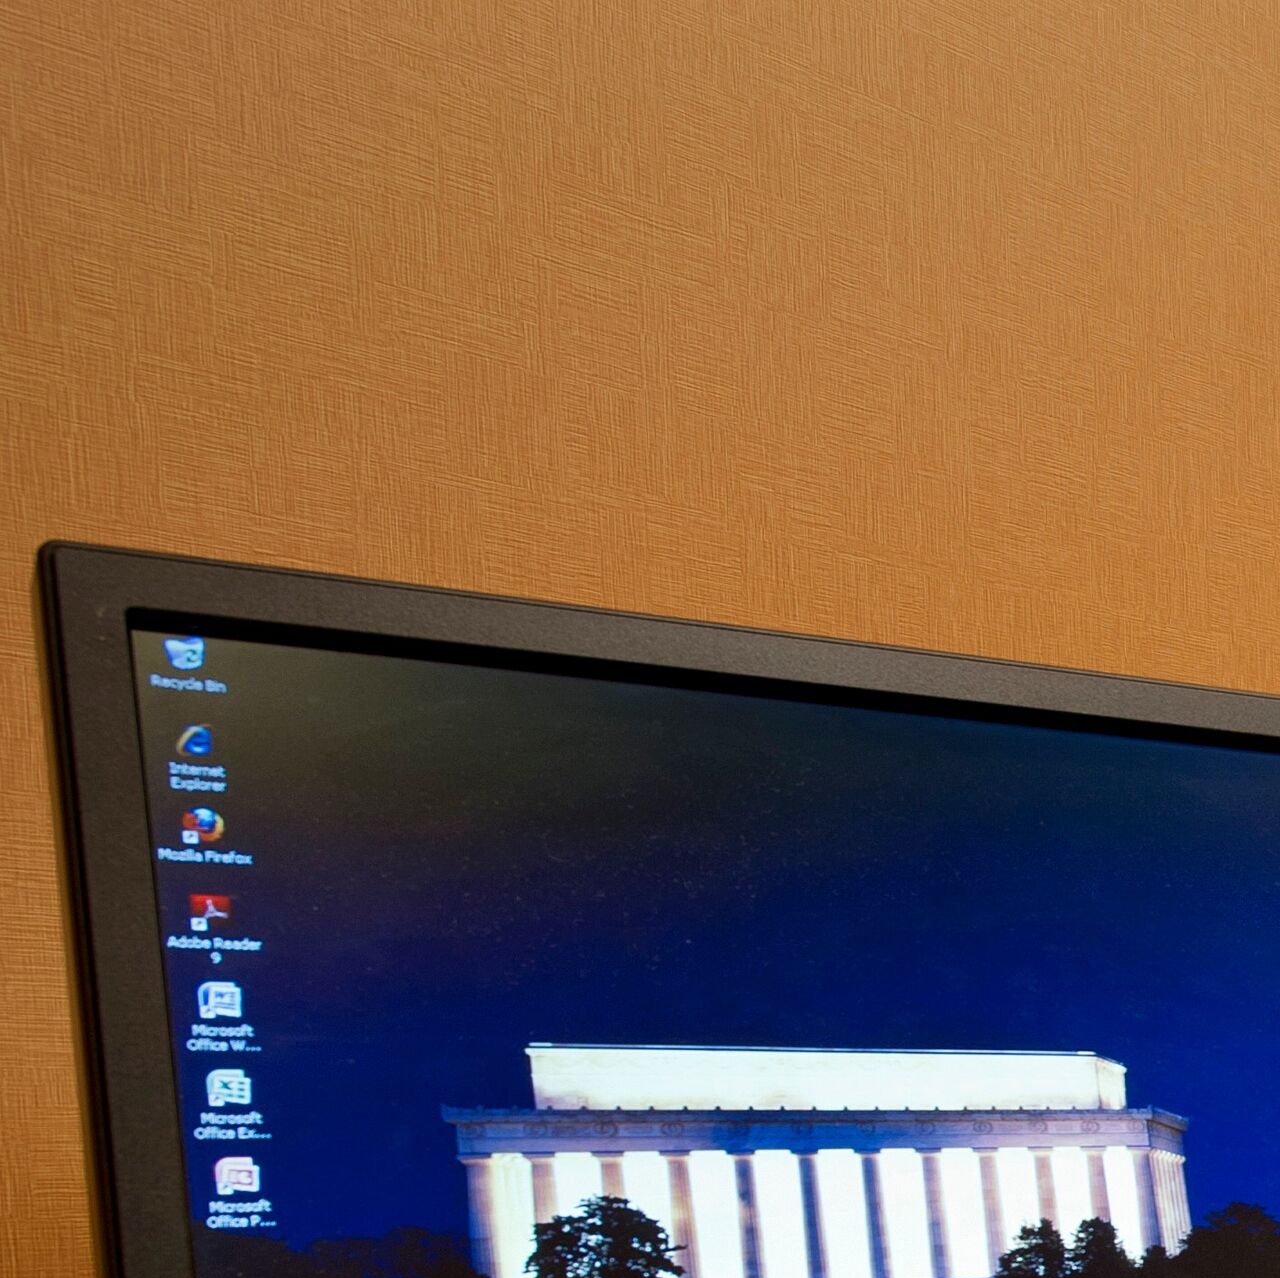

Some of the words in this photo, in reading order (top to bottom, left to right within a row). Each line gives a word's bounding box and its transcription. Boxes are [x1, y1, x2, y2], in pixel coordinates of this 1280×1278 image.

[150, 674, 203, 692] Recycle
[205, 679, 228, 693] Bin
[169, 762, 226, 778] Internet
[170, 778, 228, 792] Explorer
[157, 848, 203, 863] Mozilla
[204, 850, 253, 865] Firefox
[167, 935, 211, 950] Adobe
[212, 937, 263, 951] Reader
[210, 952, 222, 965] 9
[191, 1024, 255, 1037] Microsoft
[186, 1039, 229, 1051] Office
[200, 1112, 263, 1125] Microsoft
[194, 1127, 236, 1140] Office
[209, 1199, 272, 1213] Microsoft
[206, 1215, 248, 1228] Office
